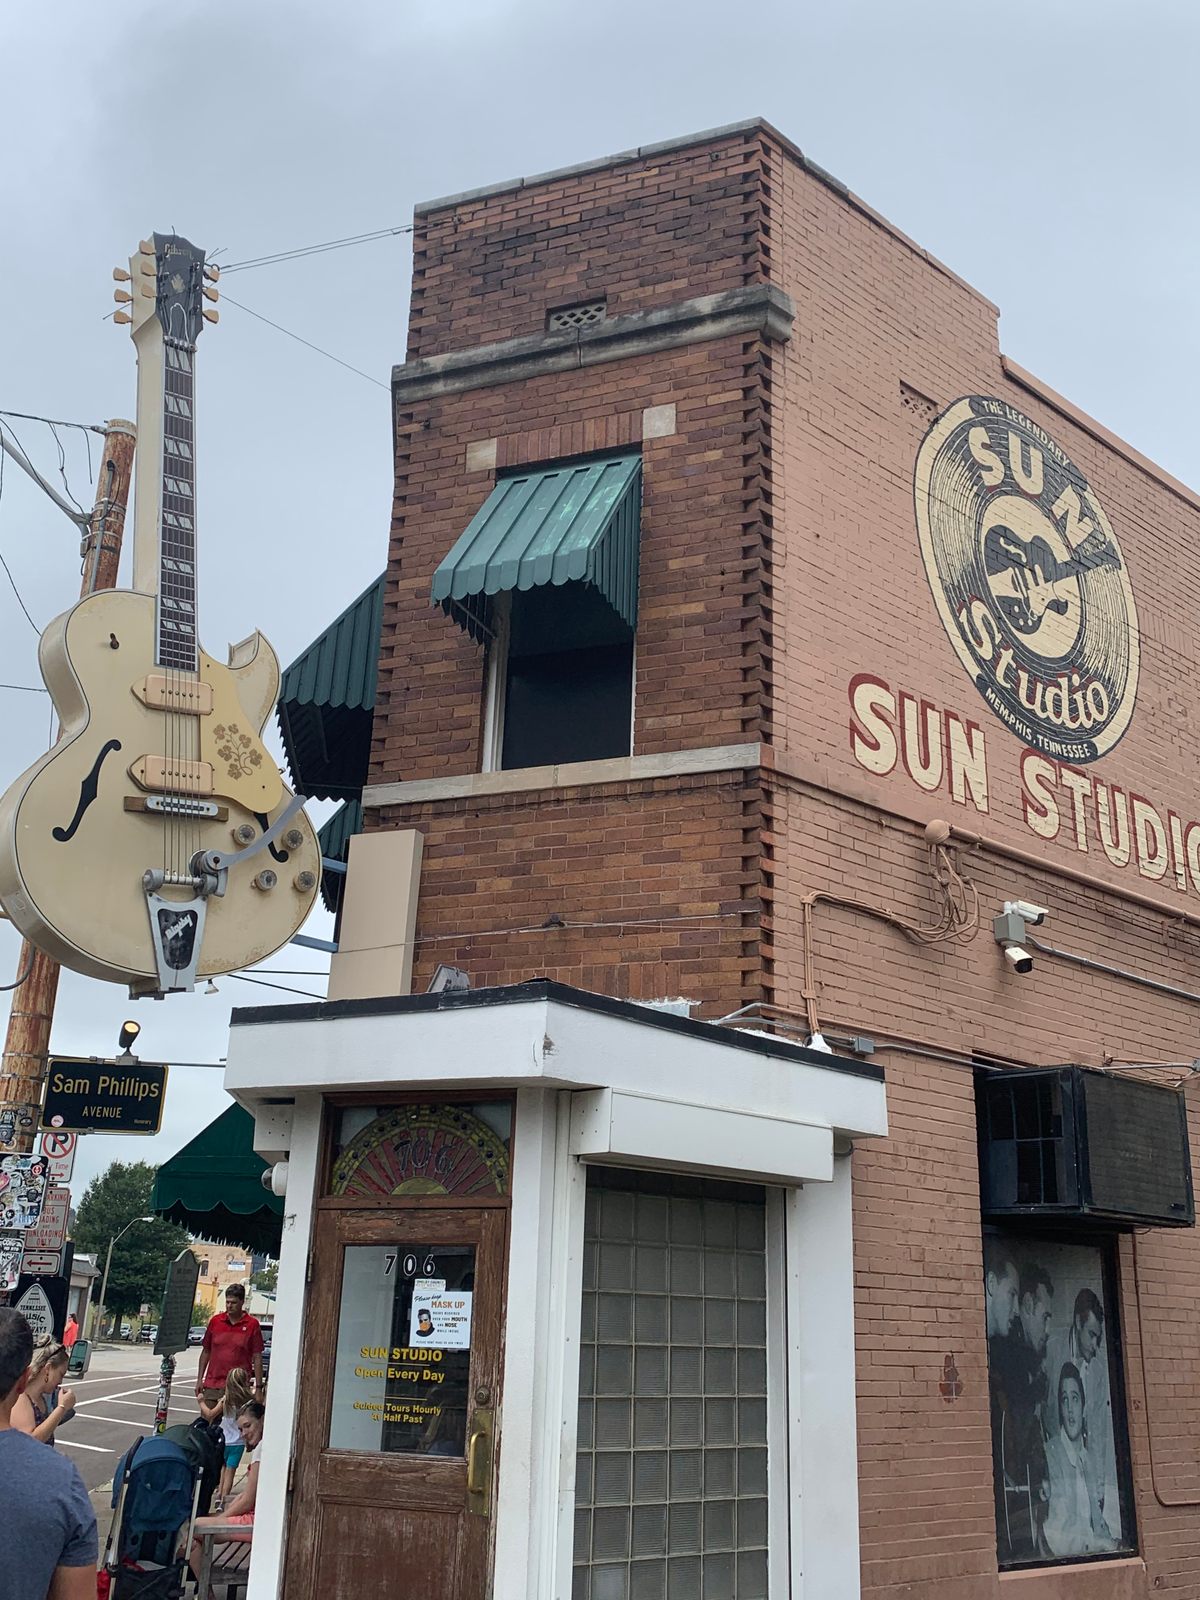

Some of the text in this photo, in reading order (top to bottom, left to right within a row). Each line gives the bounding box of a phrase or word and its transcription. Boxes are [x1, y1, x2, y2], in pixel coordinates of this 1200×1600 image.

[982, 400, 1071, 467] THE LEGENDARY
[968, 426, 1095, 550] SUN
[956, 595, 1110, 730] Studio
[848, 672, 990, 814] SUN
[1036, 733, 1093, 760] TENNESSEE
[52, 1073, 160, 1102] Sam Phillips
[82, 1105, 123, 1119] AVENUE
[393, 1137, 455, 1175] 706
[383, 1253, 437, 1277] 706
[20, 1304, 47, 1312] TENNESSEE
[431, 1300, 466, 1309] MASK UP
[25, 1313, 46, 1323] USIC
[360, 1346, 443, 1362] SUN STUDIO
[354, 1366, 446, 1384] Open Every Day
[383, 1413, 402, 1423] Half
[403, 1415, 424, 1424] Past
[385, 1403, 411, 1413] Tours
[412, 1405, 442, 1417] Hourly
